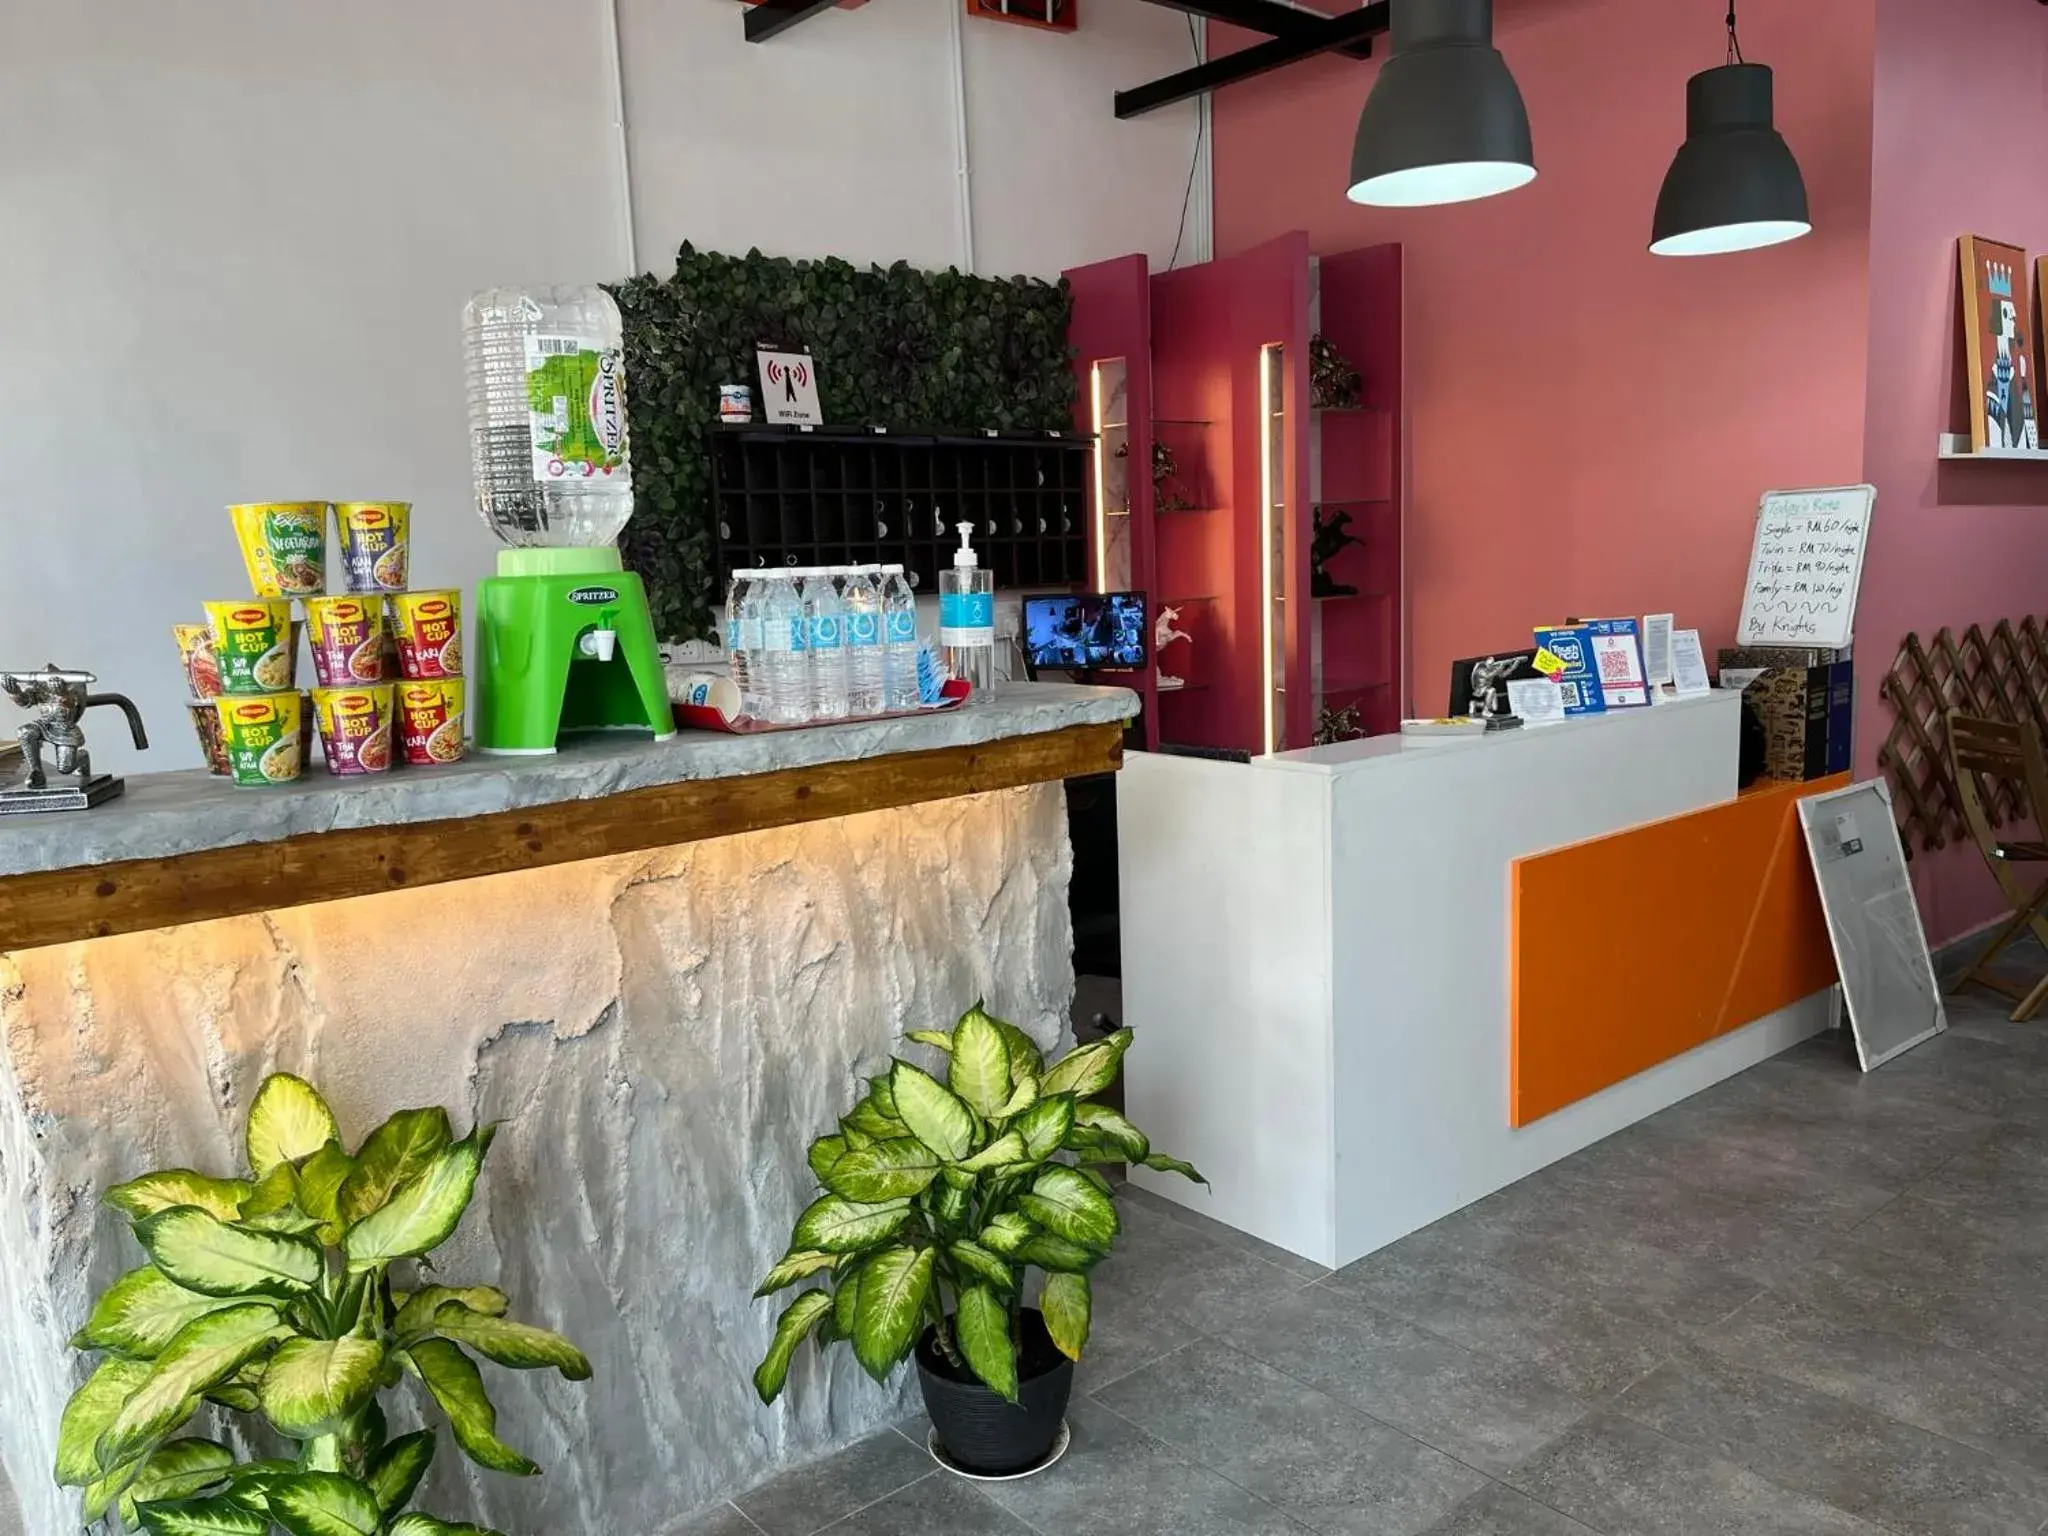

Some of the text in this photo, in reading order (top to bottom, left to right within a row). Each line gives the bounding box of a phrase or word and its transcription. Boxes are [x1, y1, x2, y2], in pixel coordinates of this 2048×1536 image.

[601, 357, 618, 456] SPRITZER
[572, 591, 616, 601] SPRITZER
[331, 625, 359, 637] HOT
[422, 621, 448, 633] HOT
[235, 632, 265, 643] HOT
[335, 636, 362, 646] CUP
[427, 631, 451, 642] CUP
[240, 642, 269, 653] CUP
[415, 648, 439, 660] KARI
[410, 710, 437, 720] HOT
[343, 717, 369, 729] HOT
[414, 719, 440, 729] CUP
[241, 726, 270, 738] HOT
[345, 727, 372, 737] CUP
[245, 736, 274, 747] CUP
